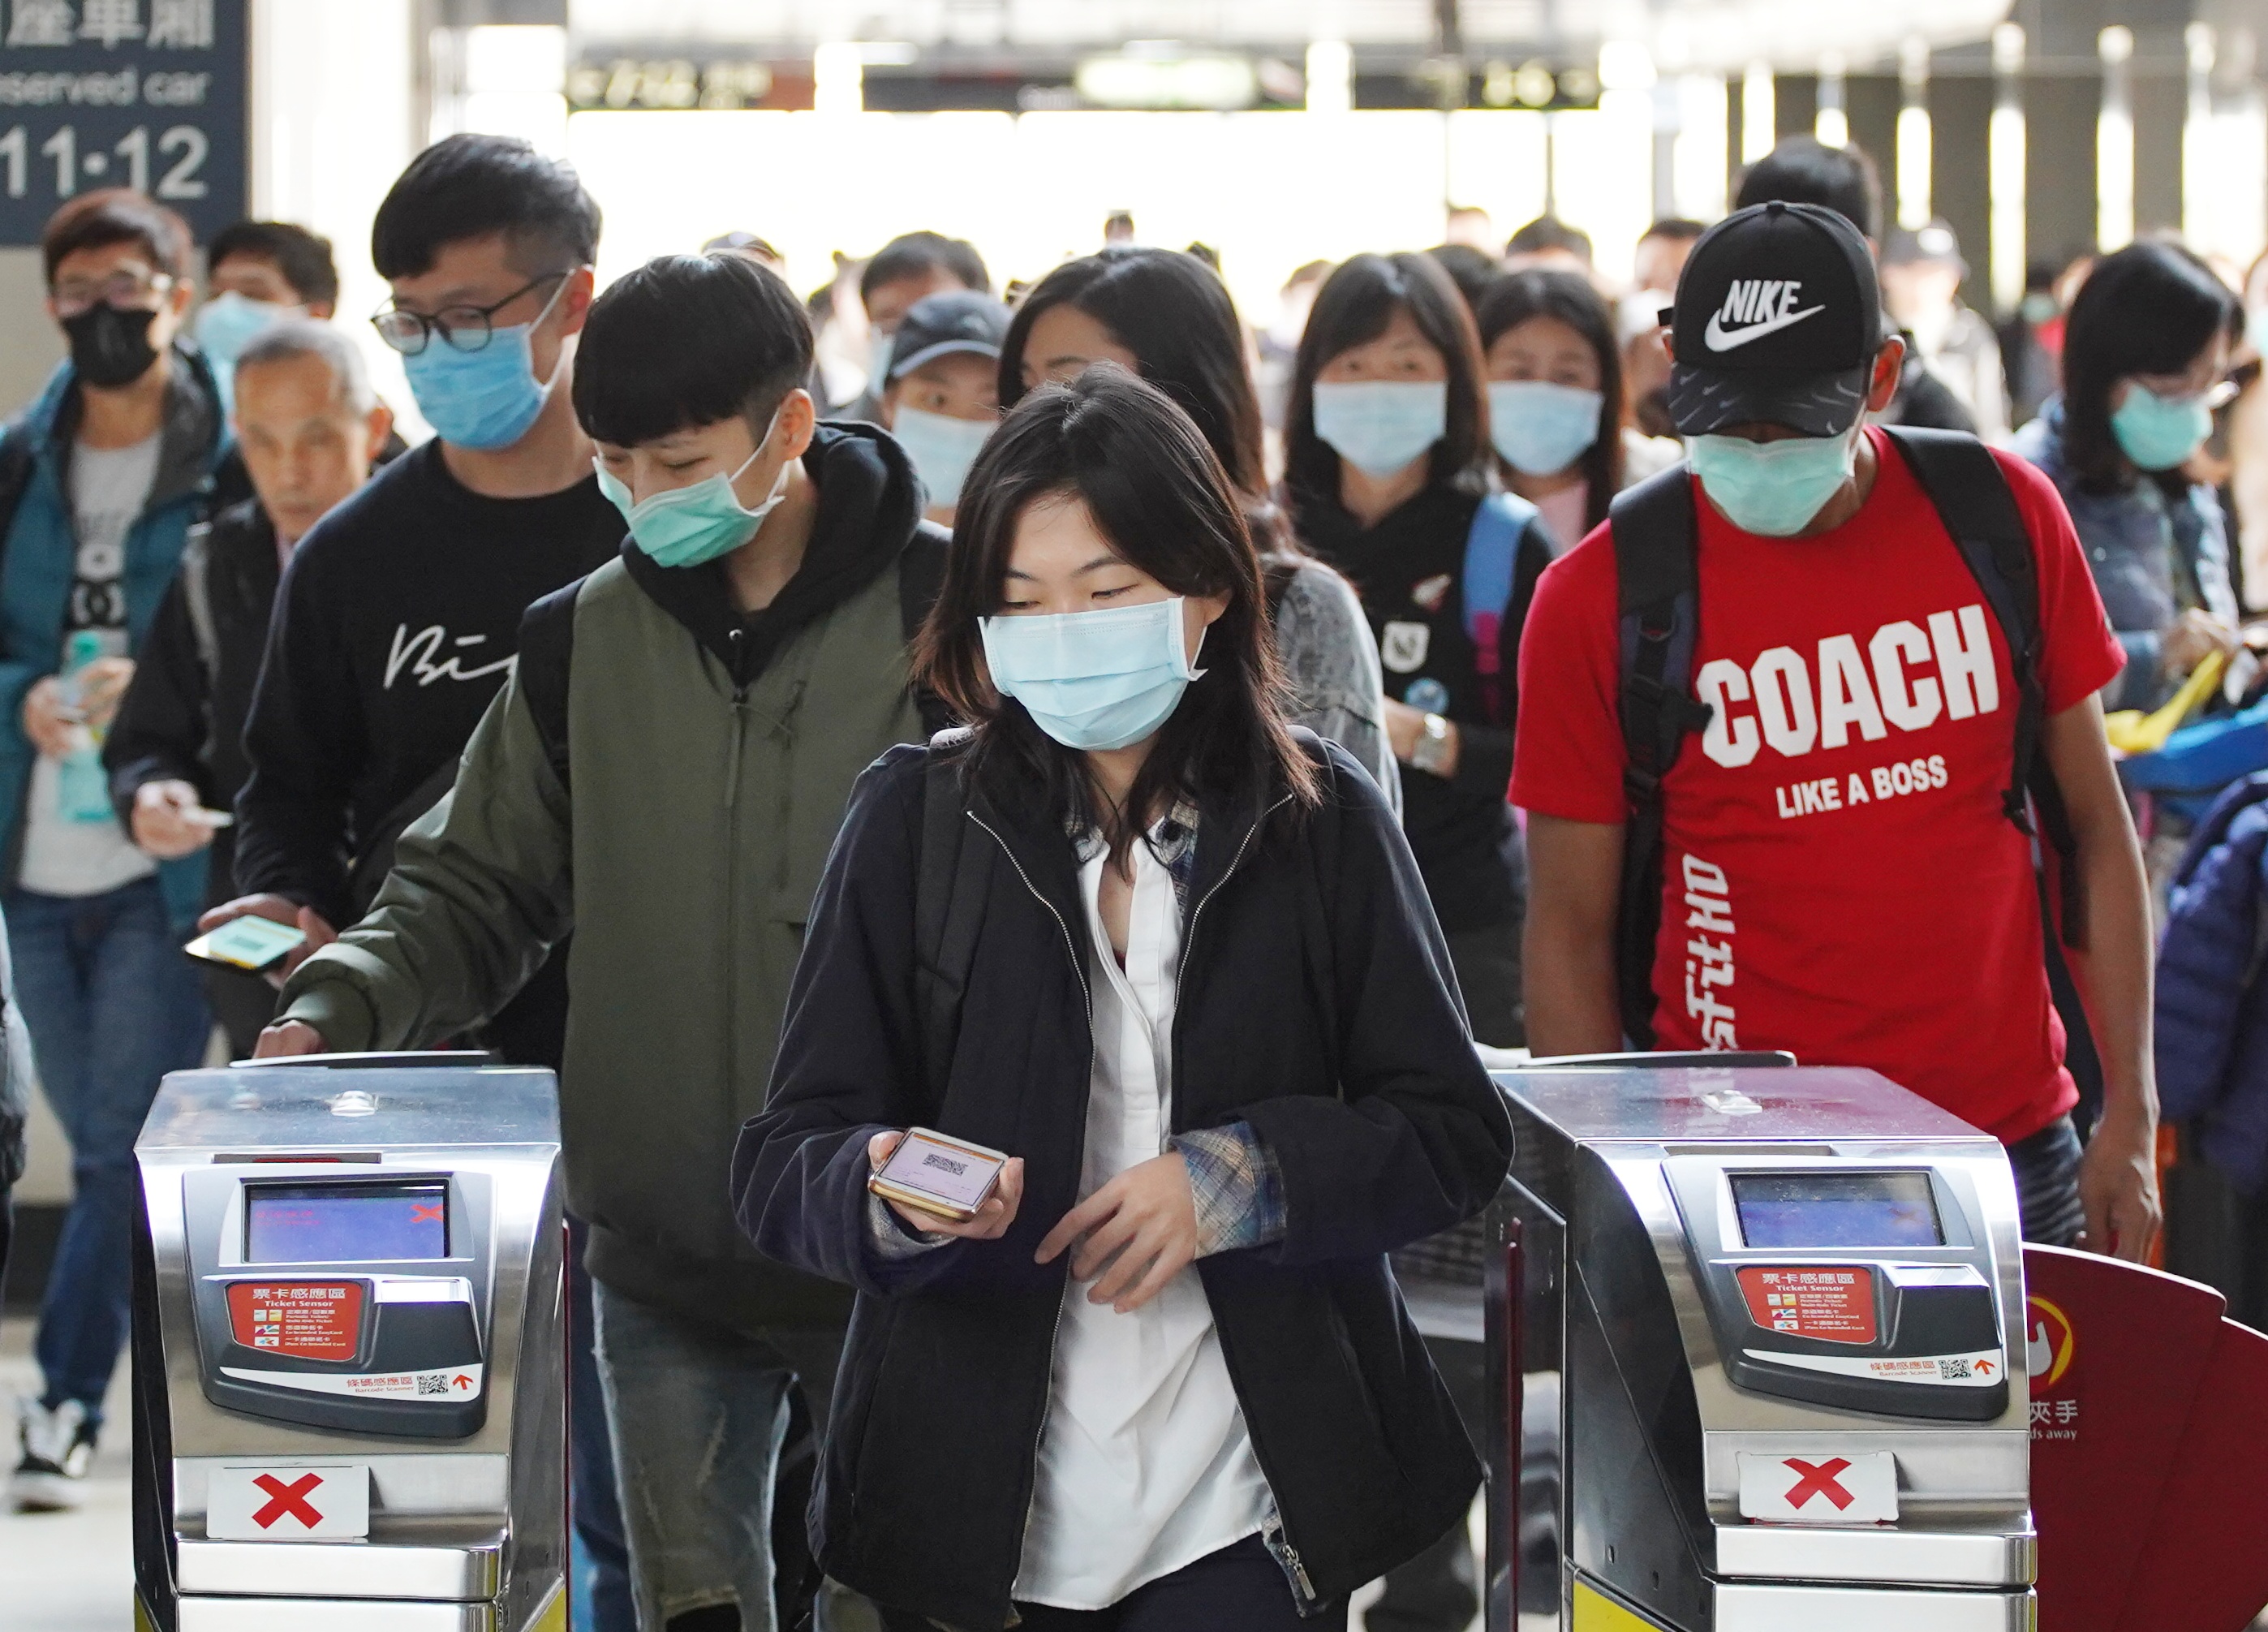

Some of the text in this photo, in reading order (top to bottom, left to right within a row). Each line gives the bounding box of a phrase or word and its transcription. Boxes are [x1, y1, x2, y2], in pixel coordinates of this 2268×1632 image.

[0, 65, 212, 106] served car
[1720, 279, 1802, 323] NIKE
[1696, 605, 1999, 769] COACH
[1775, 755, 1948, 820] LIKE A BOSS
[252, 1288, 346, 1299] 票卡感應區
[1762, 1272, 1855, 1284] 票卡感應區
[2029, 1400, 2078, 1424] 夾手
[2046, 1429, 2077, 1440] away
